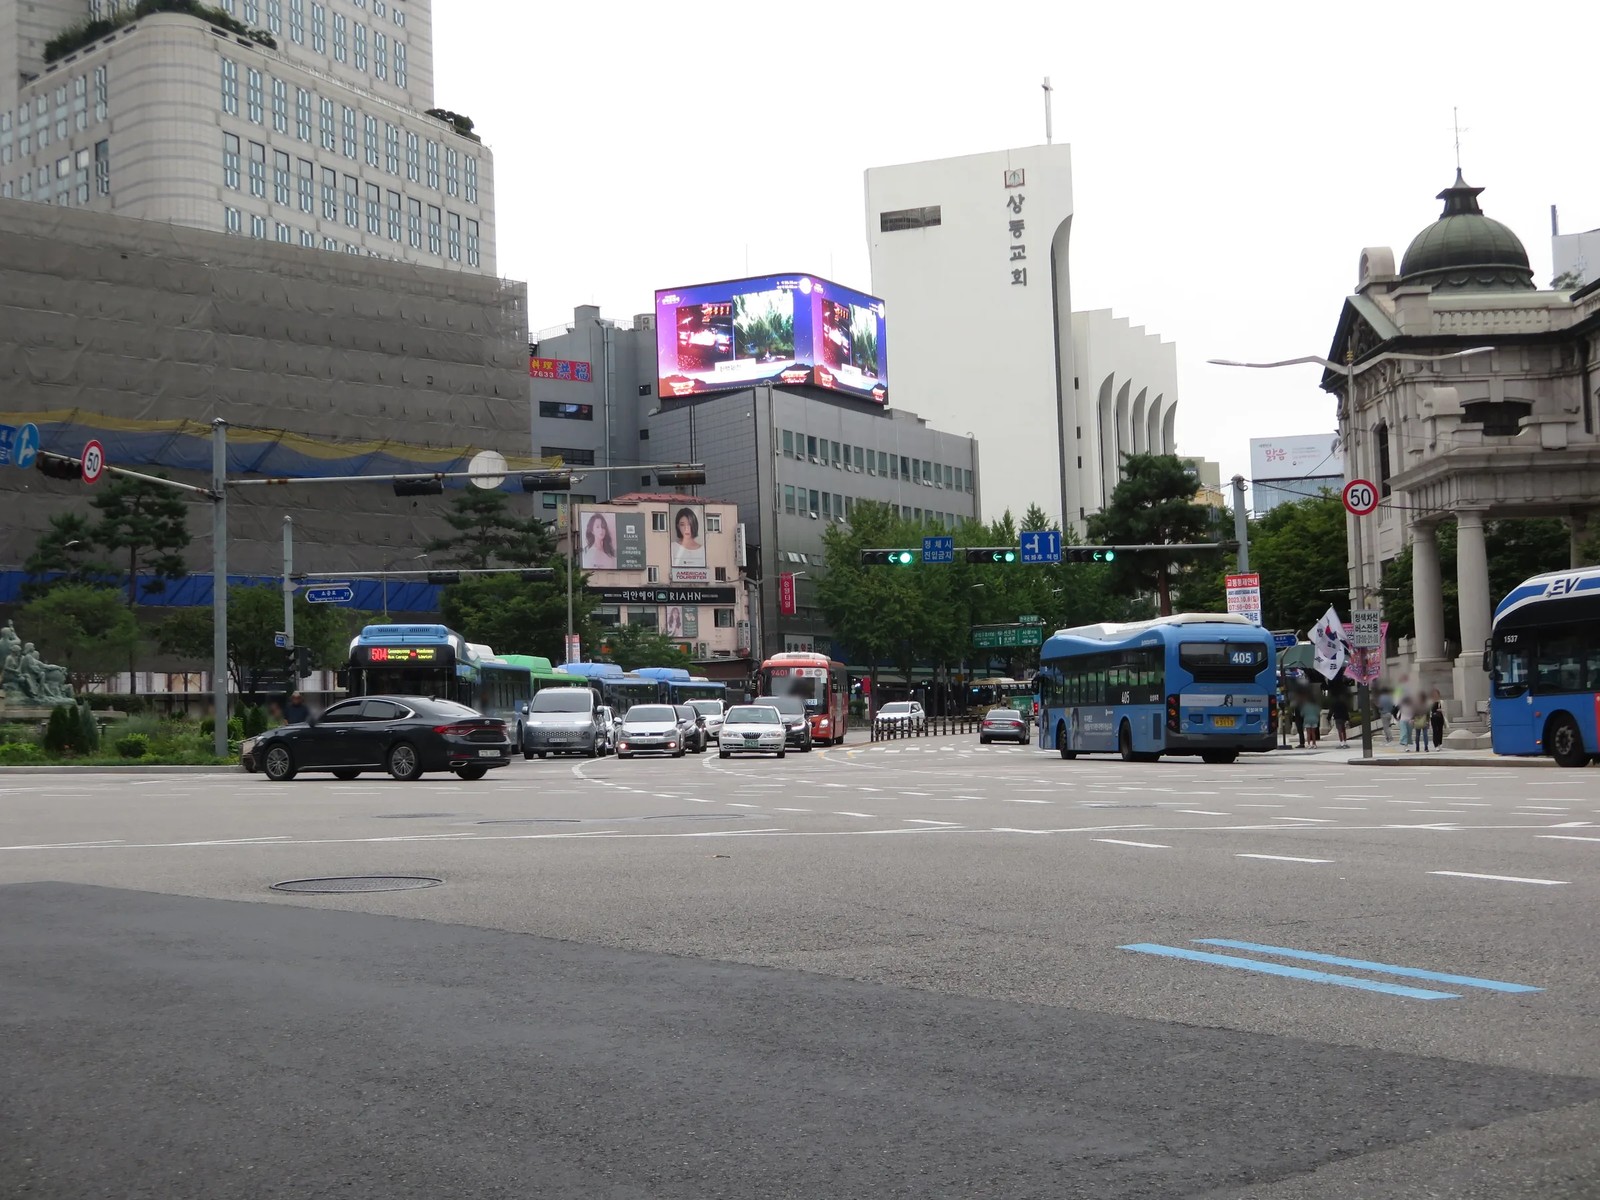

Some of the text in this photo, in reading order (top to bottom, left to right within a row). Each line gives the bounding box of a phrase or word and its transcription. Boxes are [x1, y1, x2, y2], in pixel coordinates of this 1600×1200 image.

[1006, 193, 1027, 287] 상동교회
[1265, 448, 1287, 462] 맑음
[86, 452, 100, 473] 50
[1350, 488, 1371, 506] 50
[924, 551, 952, 561] 진입금지
[1553, 577, 1580, 595] EV
[622, 590, 655, 600] 리안헤어
[669, 592, 701, 600] RIAHN
[1355, 624, 1379, 633] 버스전용
[1503, 635, 1518, 643] 1537
[371, 648, 388, 660] 504
[1232, 652, 1252, 664] 405
[1121, 691, 1130, 704] 405
